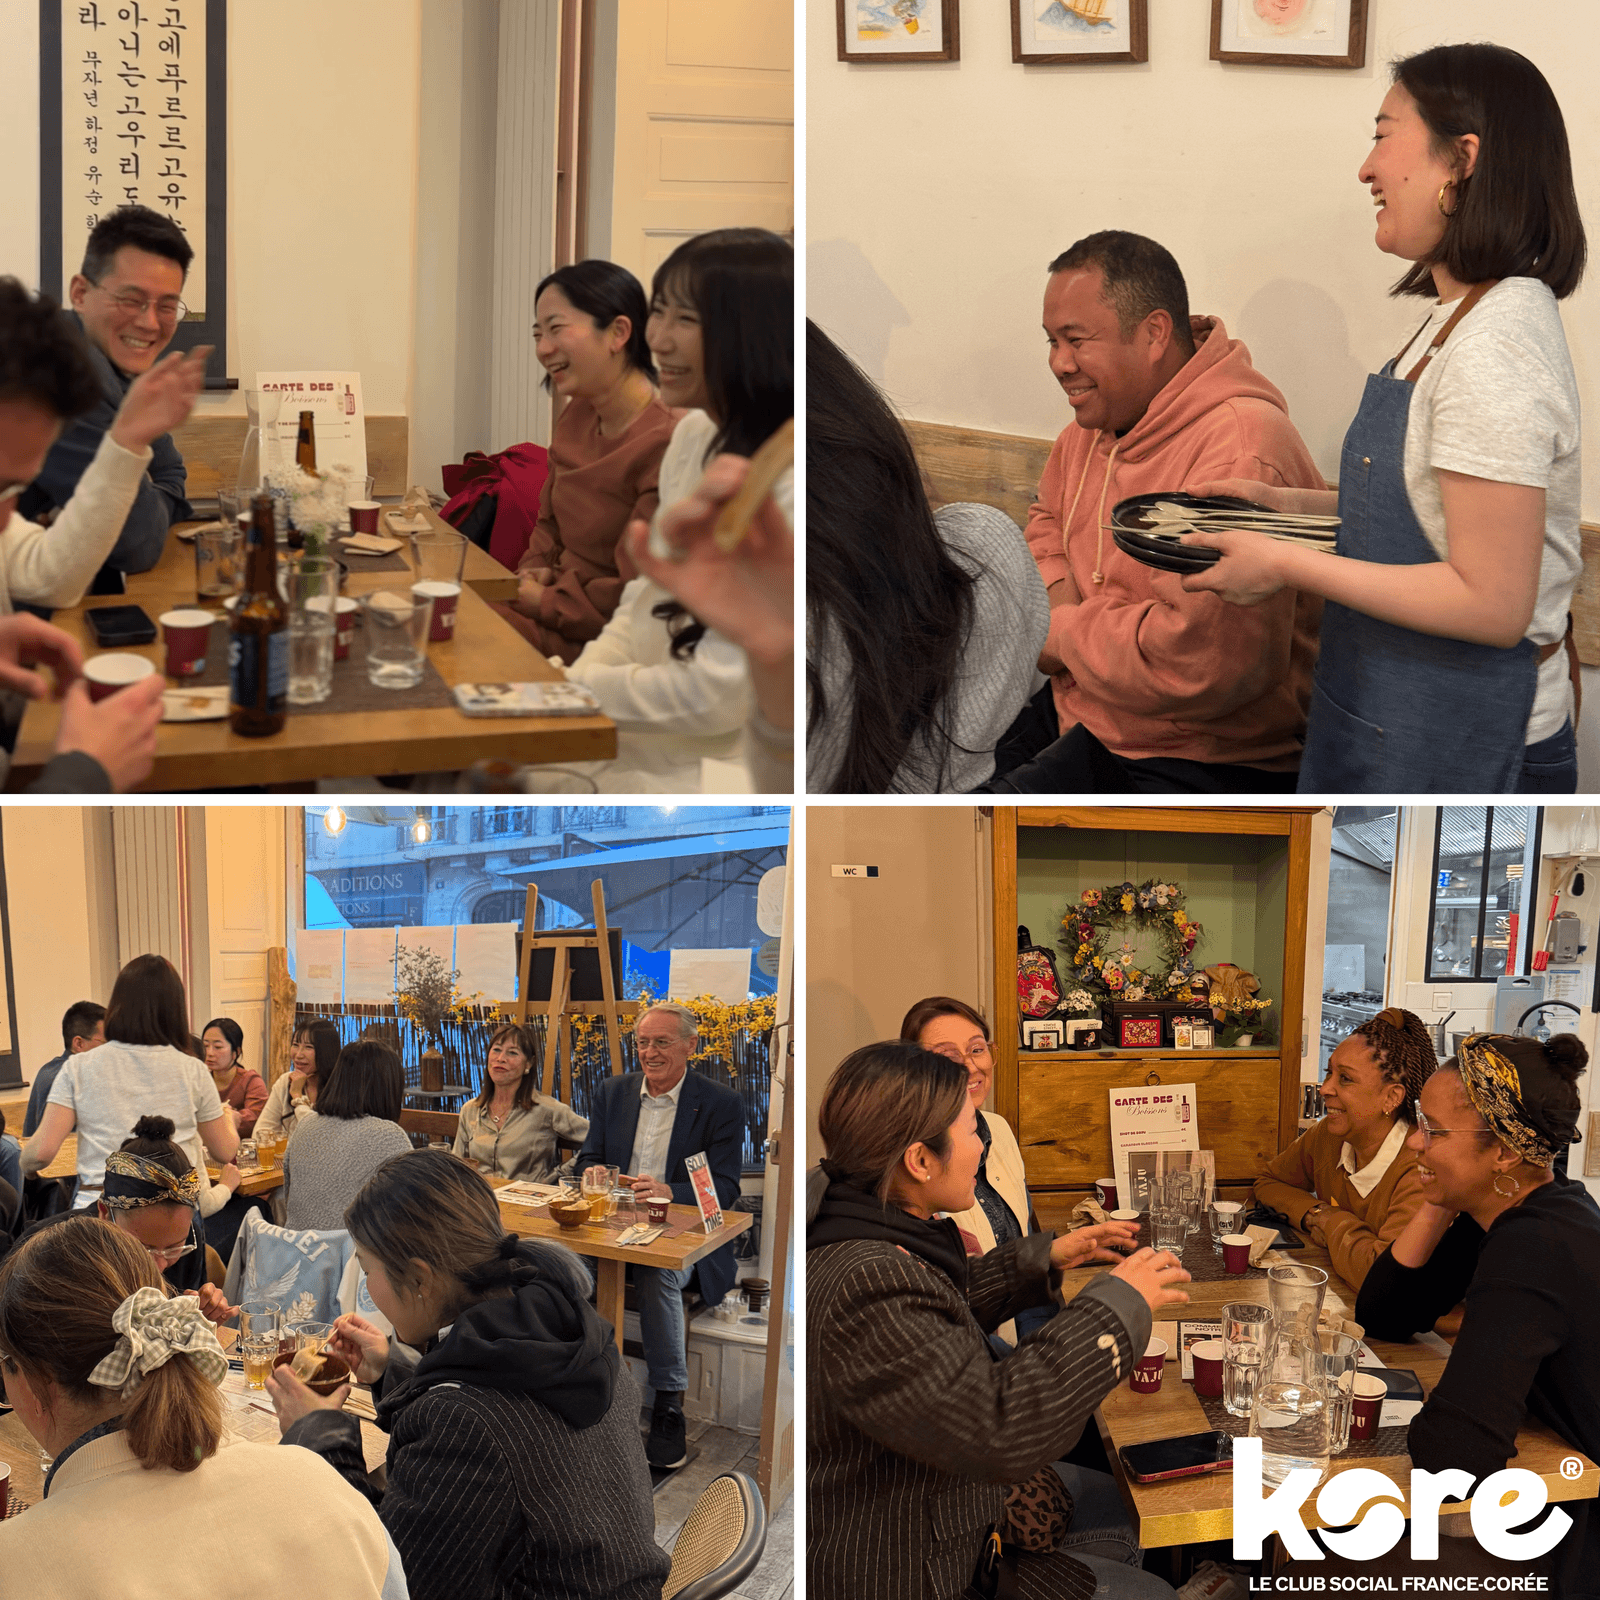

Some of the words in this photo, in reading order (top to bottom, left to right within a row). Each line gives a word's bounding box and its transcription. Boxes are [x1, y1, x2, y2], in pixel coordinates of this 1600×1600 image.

[78, 1, 107, 32] 라
[82, 50, 102, 108] 무자년
[157, 0, 188, 233] 고에푸르르고유
[262, 382, 304, 392] CARTE
[309, 382, 334, 392] DES
[336, 901, 371, 915] TIONS
[1114, 1097, 1148, 1106] CARTE
[1153, 1096, 1173, 1104] DES
[1137, 1168, 1149, 1198] YAJU
[705, 1211, 723, 1233] TIME
[1133, 1368, 1164, 1383] YAJU
